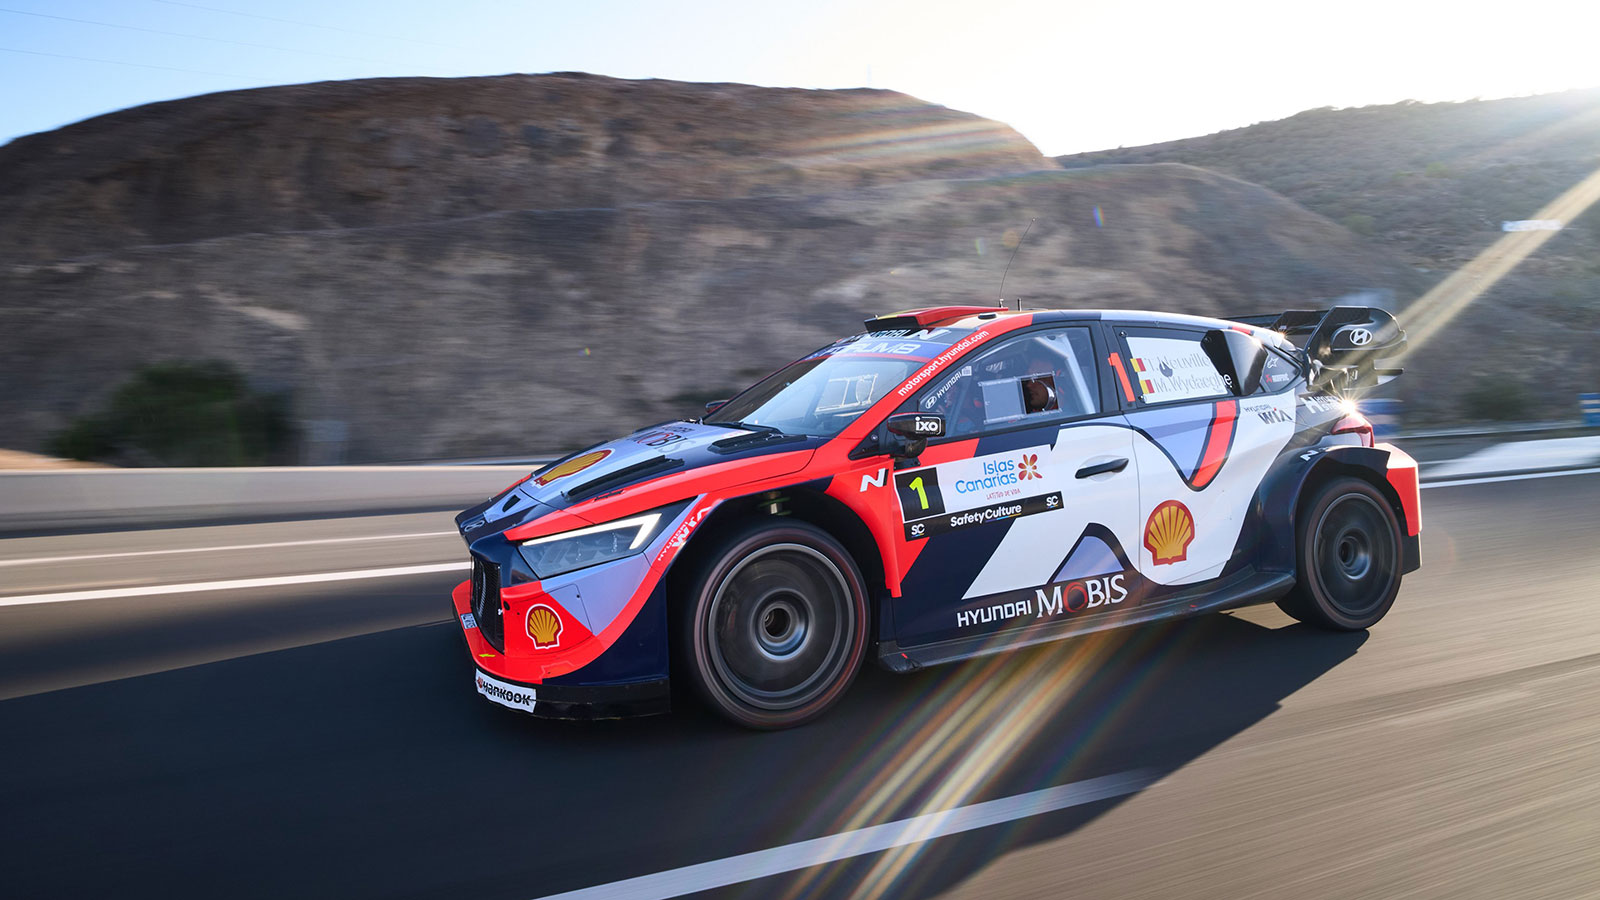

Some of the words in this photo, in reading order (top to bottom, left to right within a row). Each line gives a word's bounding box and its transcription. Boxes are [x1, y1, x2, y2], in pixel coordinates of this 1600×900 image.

[898, 330, 989, 396] motorsport.hyundai.com
[937, 371, 963, 398] HYUNDAI
[1108, 352, 1136, 402] 1
[983, 459, 1015, 475] Islas
[909, 477, 929, 510] 1
[955, 472, 1018, 494] Canarias
[1046, 496, 1059, 506] SC
[950, 504, 1022, 527] SafetyCulture
[911, 523, 925, 535] SC
[957, 600, 1032, 627] HYUNDAI
[1035, 574, 1128, 618] MOBIS
